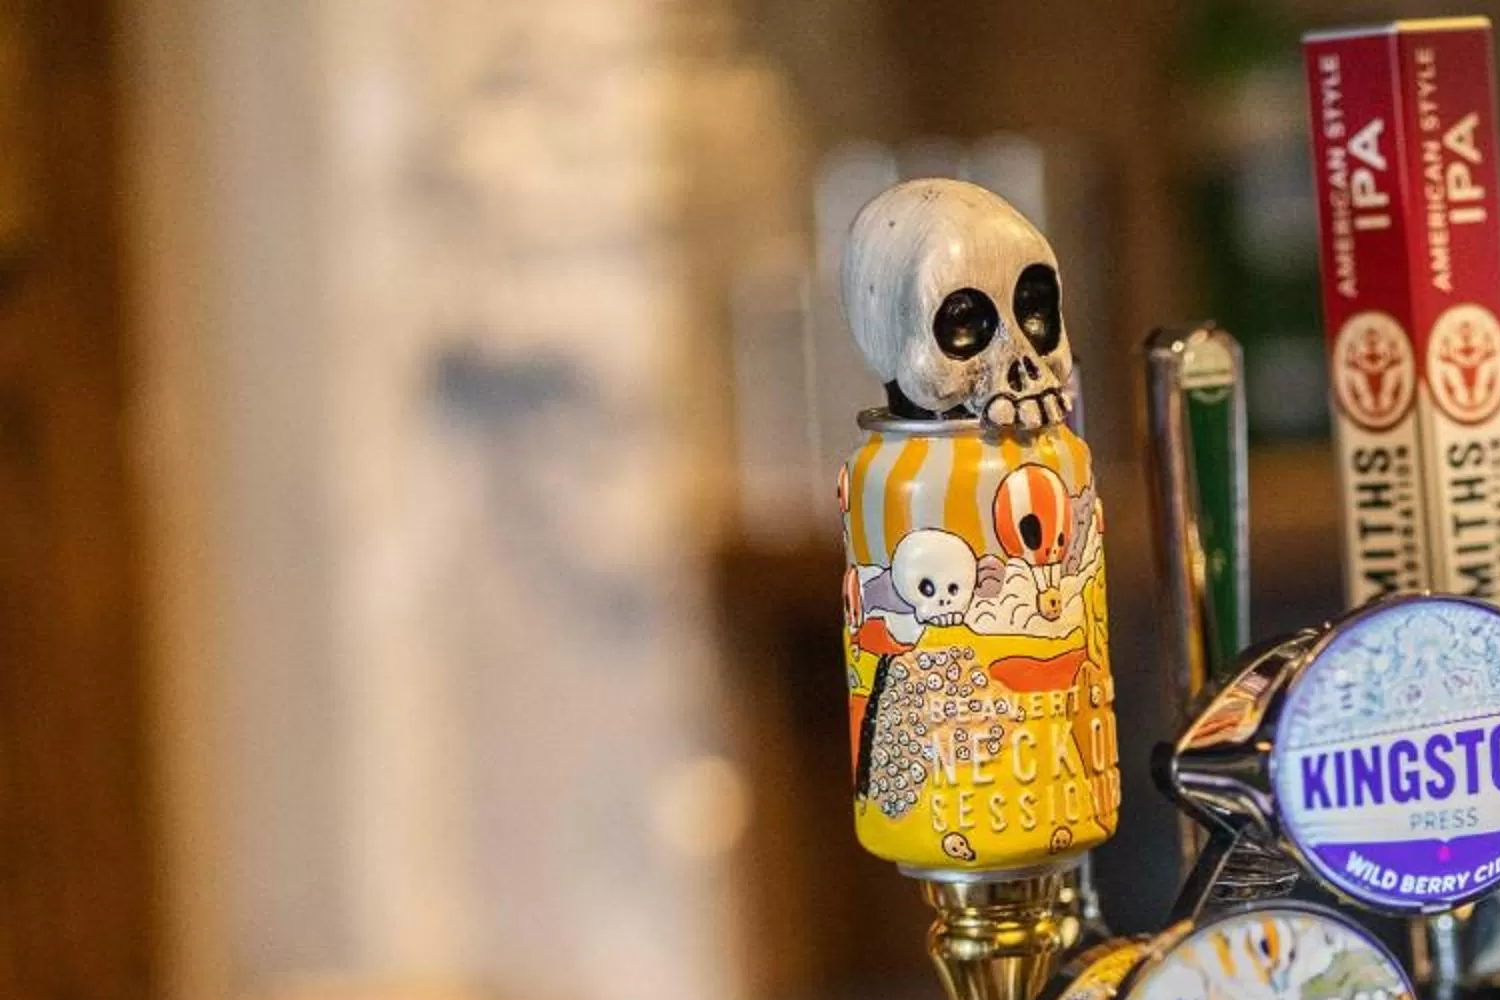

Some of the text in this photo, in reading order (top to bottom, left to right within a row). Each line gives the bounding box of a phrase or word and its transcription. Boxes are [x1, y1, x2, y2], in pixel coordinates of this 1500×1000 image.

[1319, 53, 1359, 298] AMERICAN STYLE
[1347, 117, 1391, 230] IPA
[1414, 49, 1453, 292] AMERICAN STYLE
[1442, 112, 1487, 224] IPA
[1354, 447, 1400, 597] MITHS
[1447, 440, 1493, 598] MITHS
[930, 720, 1077, 787] NECK
[1346, 850, 1398, 889] WILD
[1400, 871, 1470, 894] BERRY
[1409, 807, 1479, 831] PRESS
